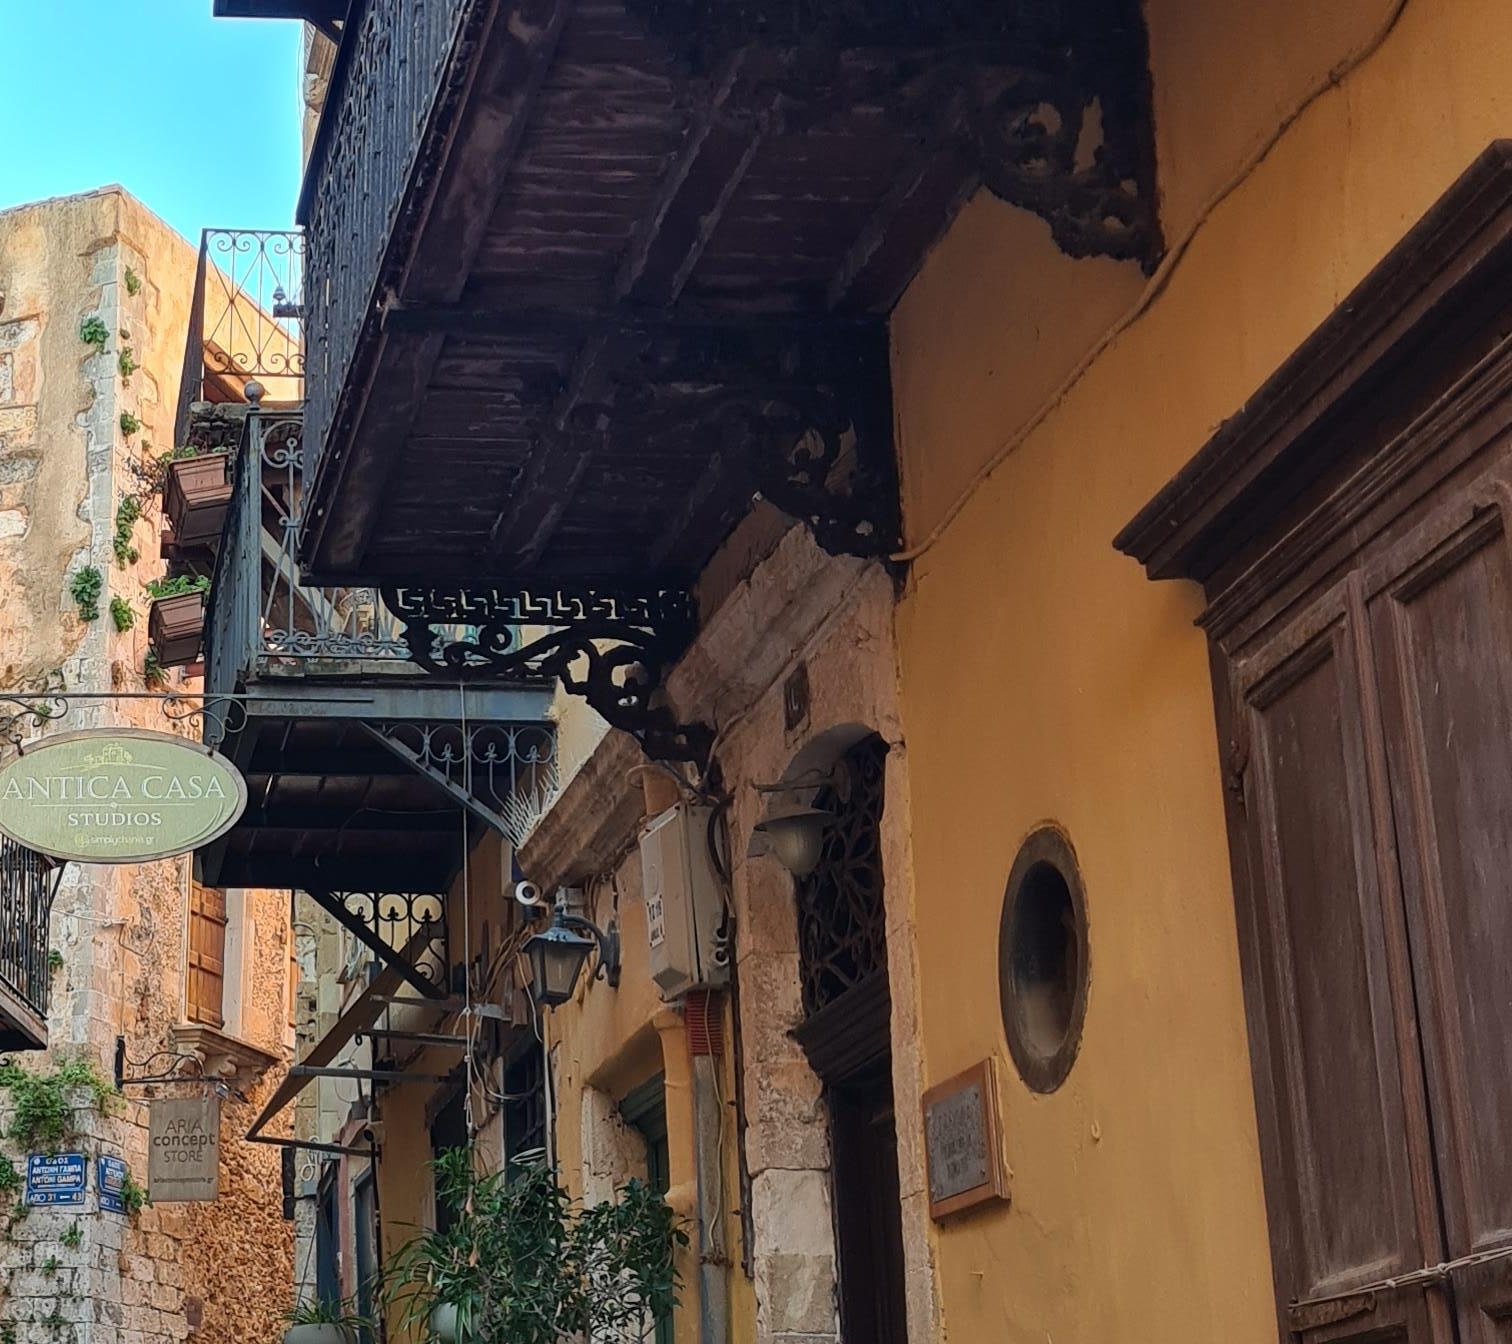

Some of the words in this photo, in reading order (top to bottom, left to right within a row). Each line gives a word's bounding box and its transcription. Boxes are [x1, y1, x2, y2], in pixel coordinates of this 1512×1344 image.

[1, 775, 132, 800] ANTICA
[141, 775, 226, 800] CASA
[68, 812, 162, 827] STUDIOS
[165, 1119, 203, 1134] ARIA
[153, 1133, 216, 1150] concept
[164, 1150, 203, 1163] STORE
